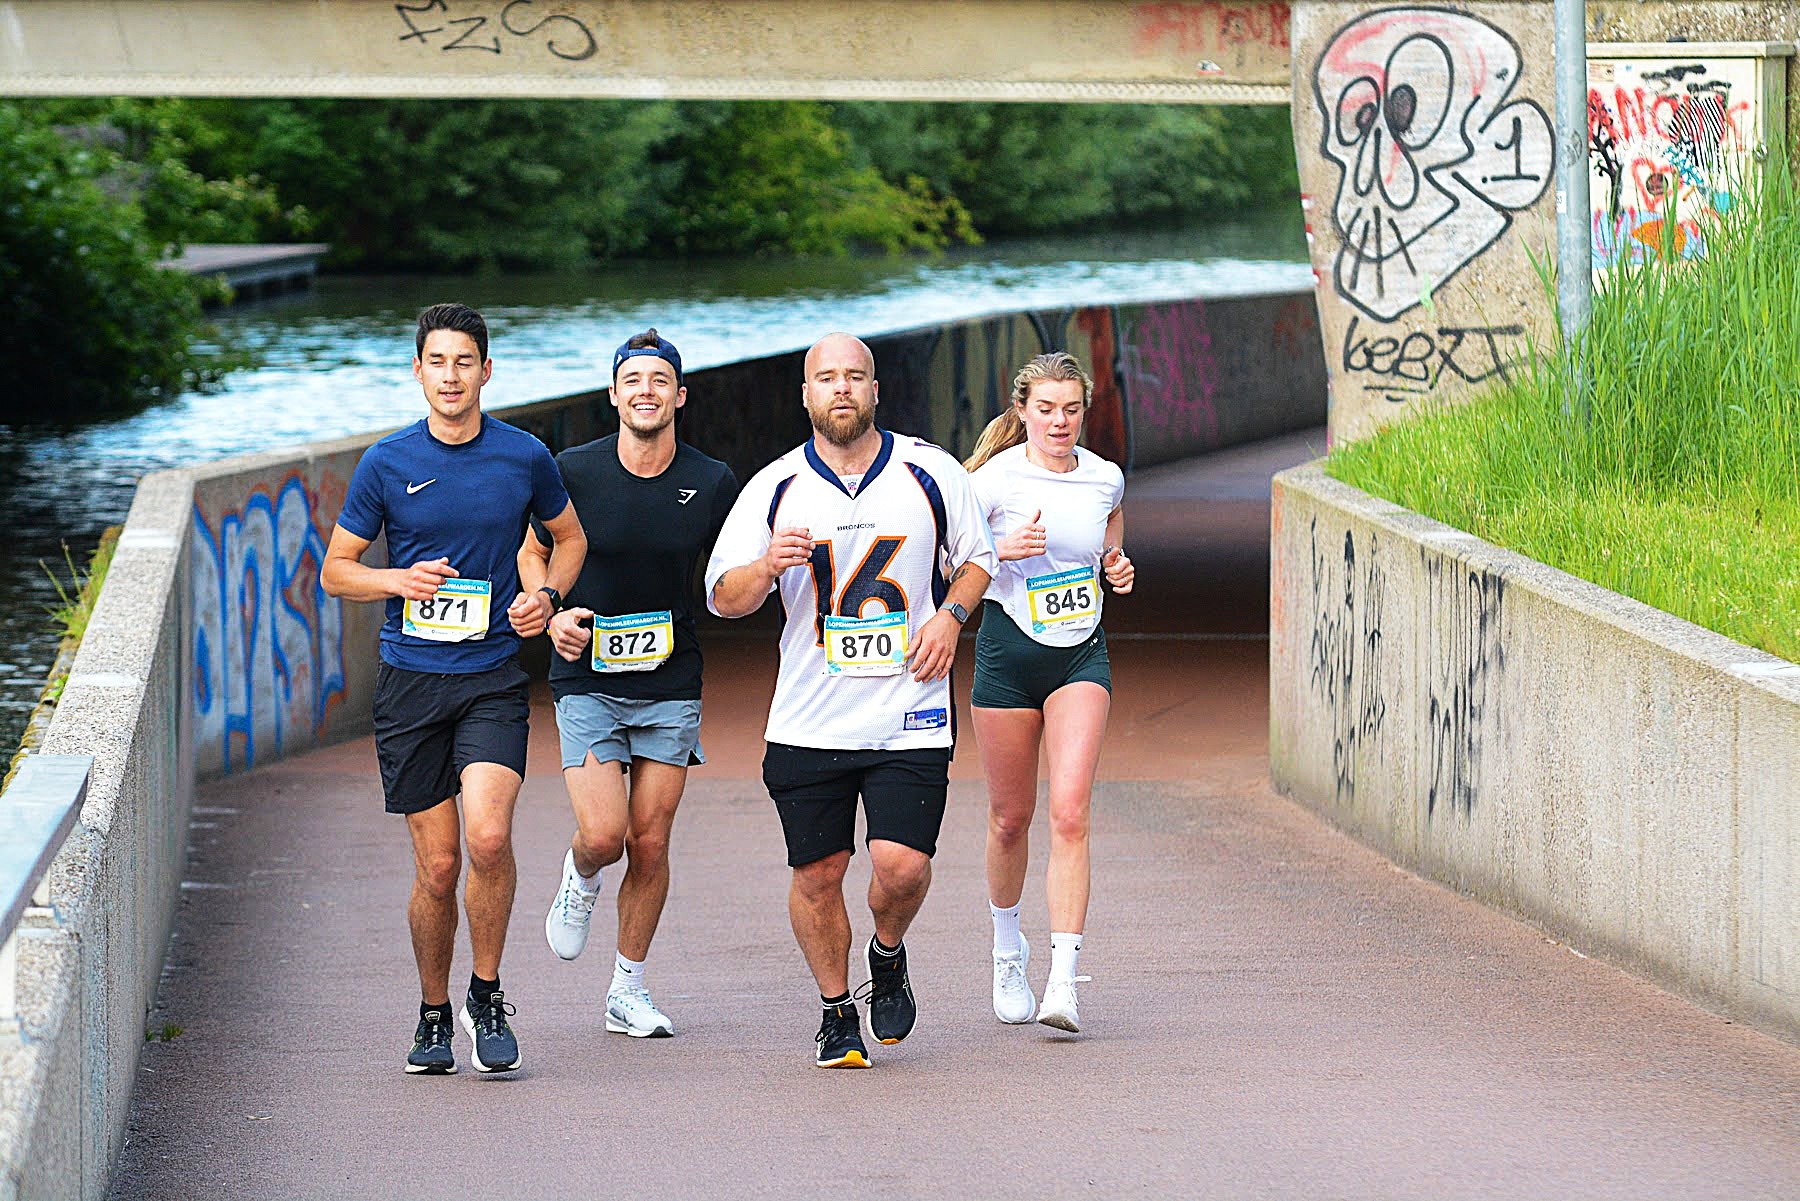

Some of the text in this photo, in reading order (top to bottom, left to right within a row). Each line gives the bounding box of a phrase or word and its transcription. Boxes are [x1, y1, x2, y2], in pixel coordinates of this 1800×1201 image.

[837, 523, 876, 531] BRONCOS
[806, 536, 909, 647] 16
[1045, 586, 1091, 615] 845
[419, 597, 468, 623] 871
[609, 631, 656, 656] 872
[841, 633, 892, 659] 870
